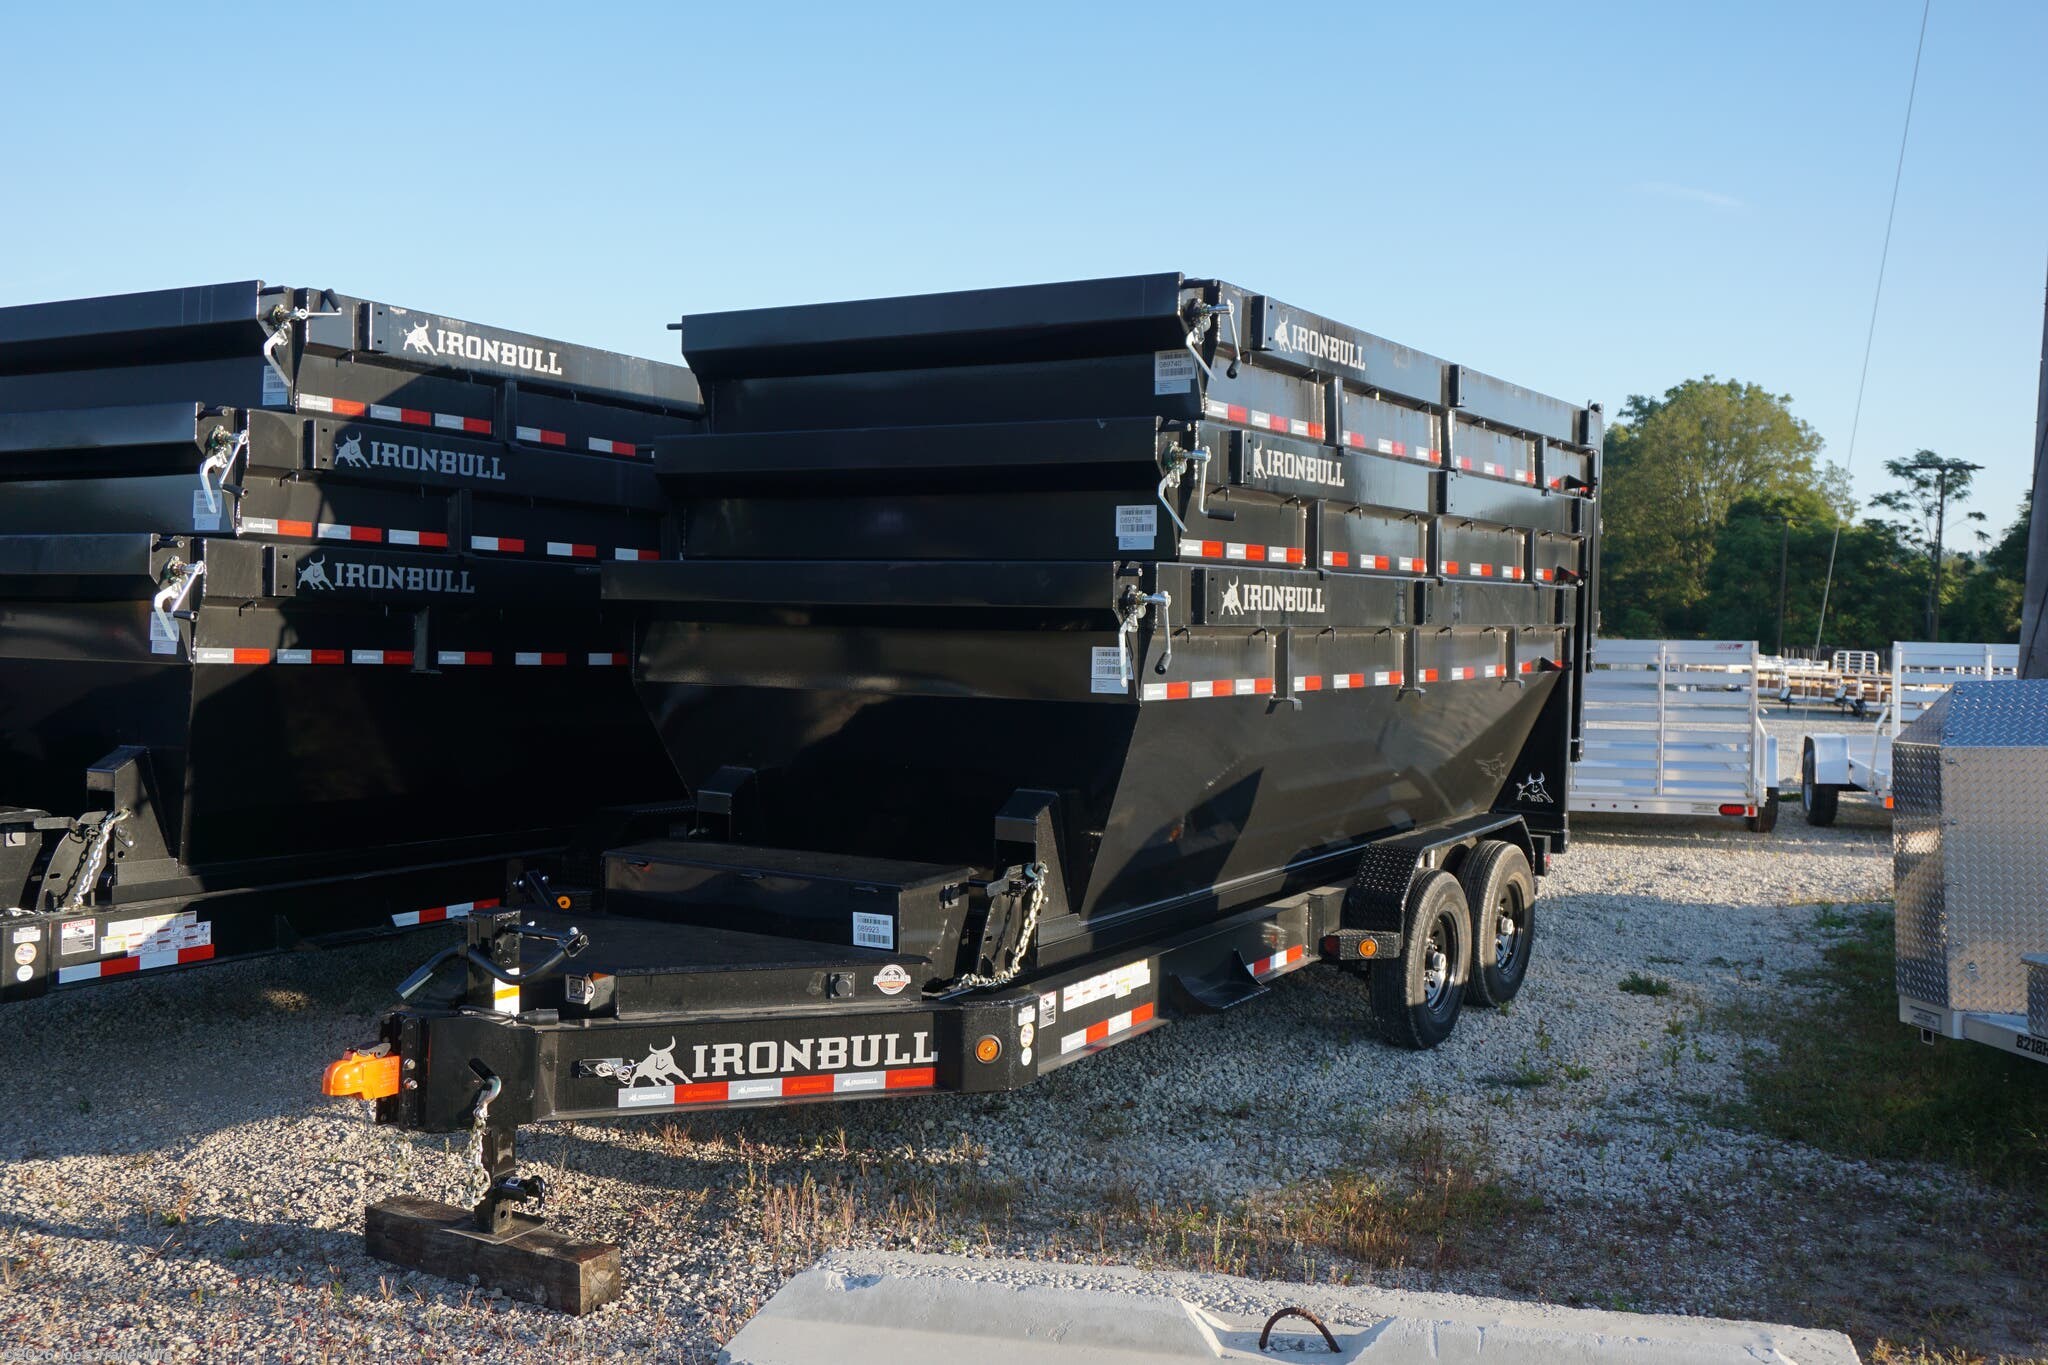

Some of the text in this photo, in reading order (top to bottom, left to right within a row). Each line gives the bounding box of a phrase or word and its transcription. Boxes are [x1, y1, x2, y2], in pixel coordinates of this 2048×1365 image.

[437, 328, 563, 376] IRONBULL
[1292, 323, 1366, 371] IRONBULL
[370, 440, 506, 481] IRONBULL
[1266, 448, 1345, 487] IRONBULL
[334, 562, 475, 594] IRONBULL
[1243, 582, 1325, 613] IRONBULL
[692, 1031, 938, 1077] IRONBULL
